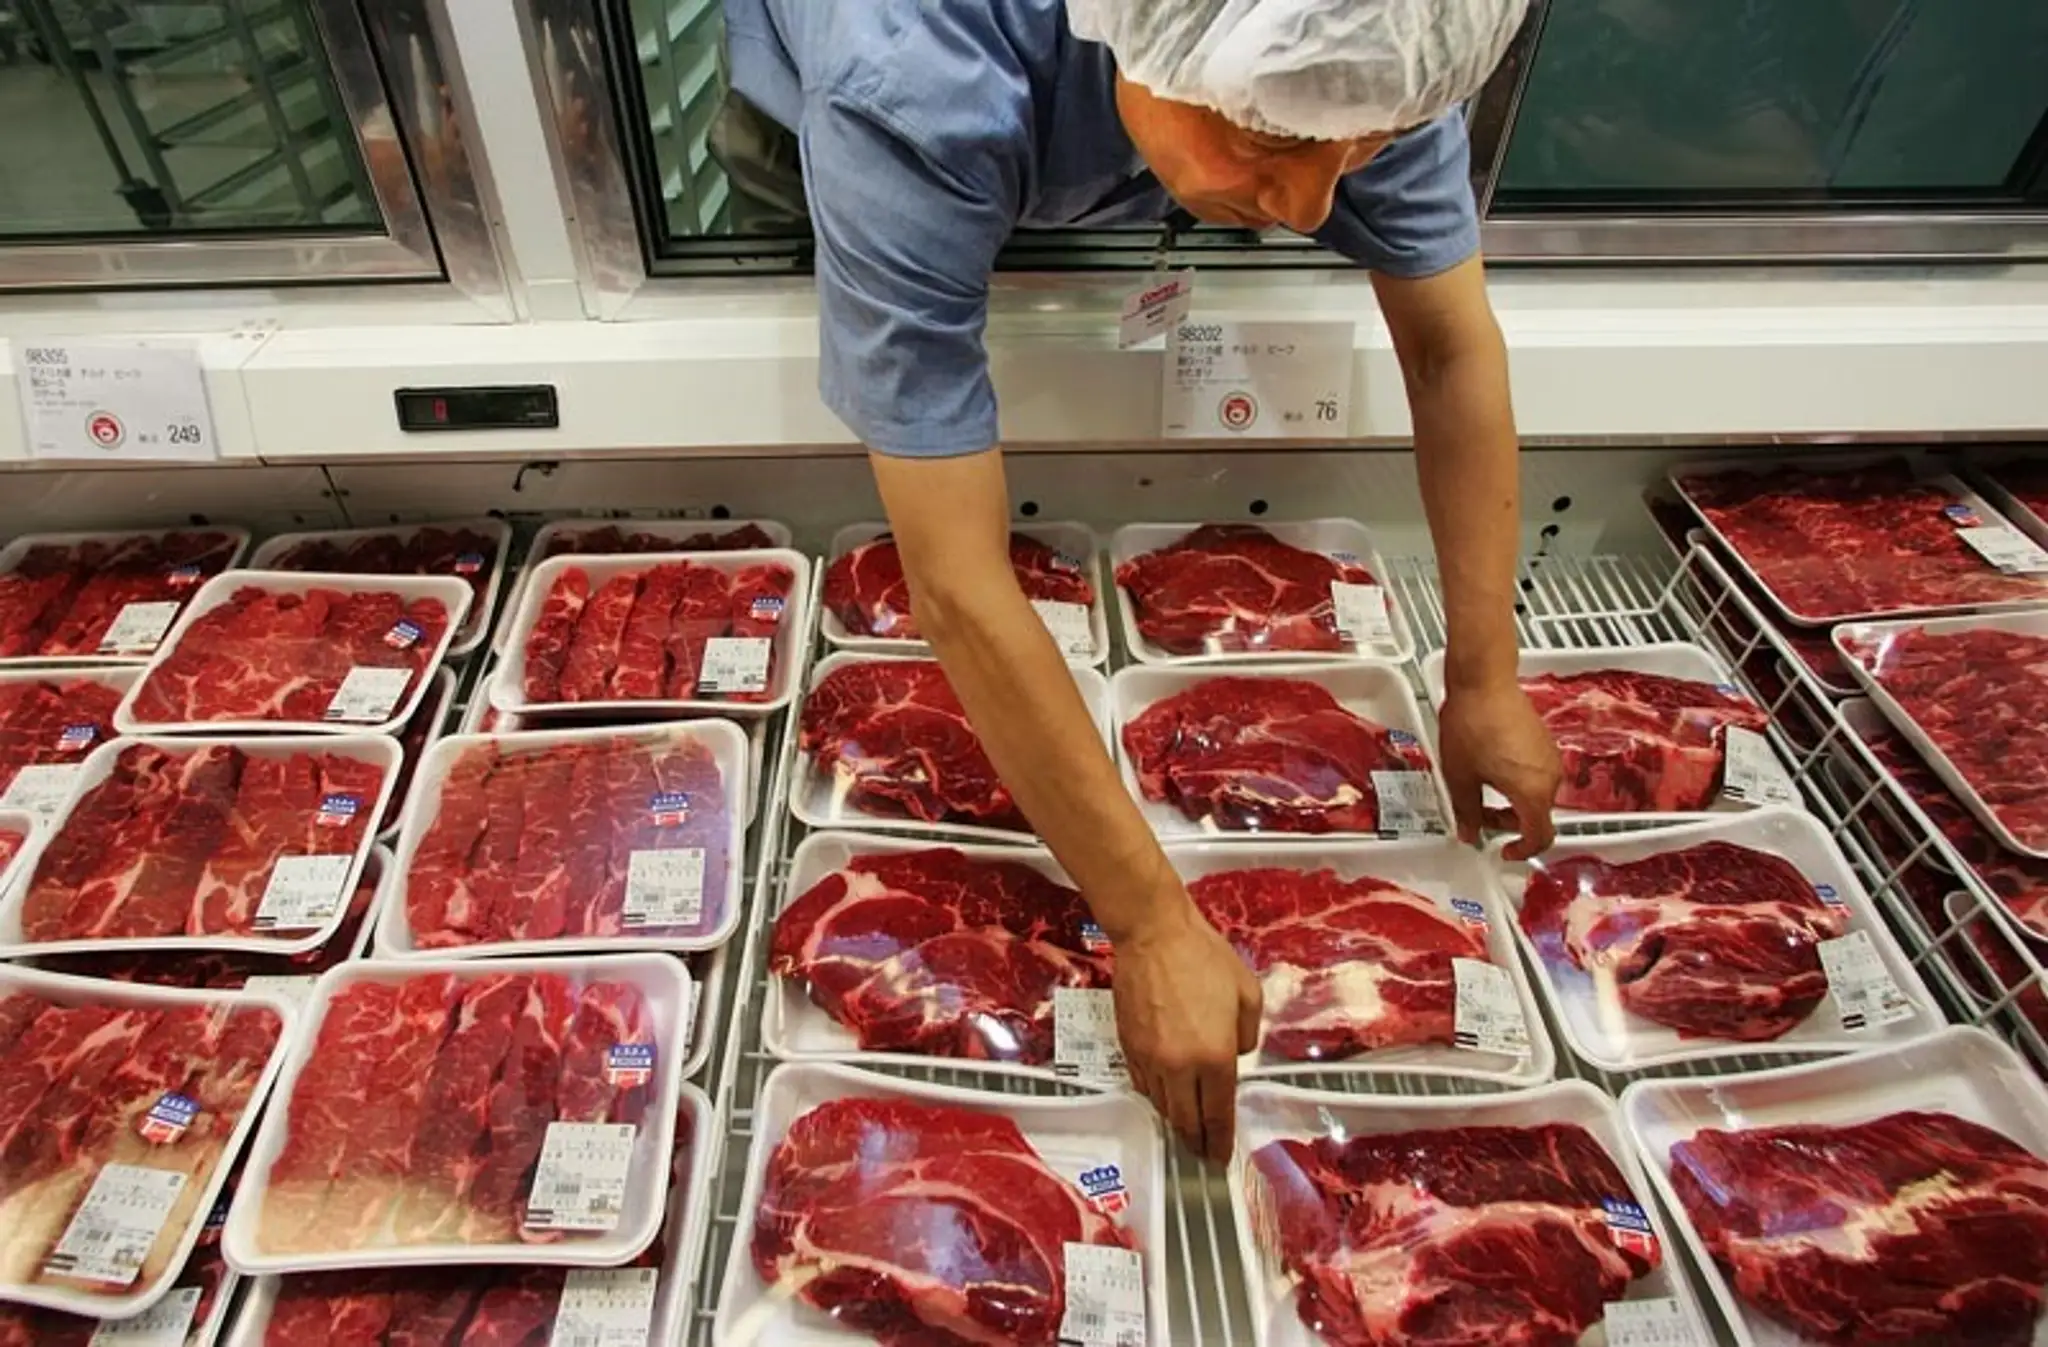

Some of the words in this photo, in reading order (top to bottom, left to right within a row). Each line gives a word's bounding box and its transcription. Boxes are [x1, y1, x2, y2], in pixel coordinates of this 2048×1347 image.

[1177, 325, 1222, 342] 98202
[1315, 401, 1338, 421] 76
[167, 424, 201, 444] 249
